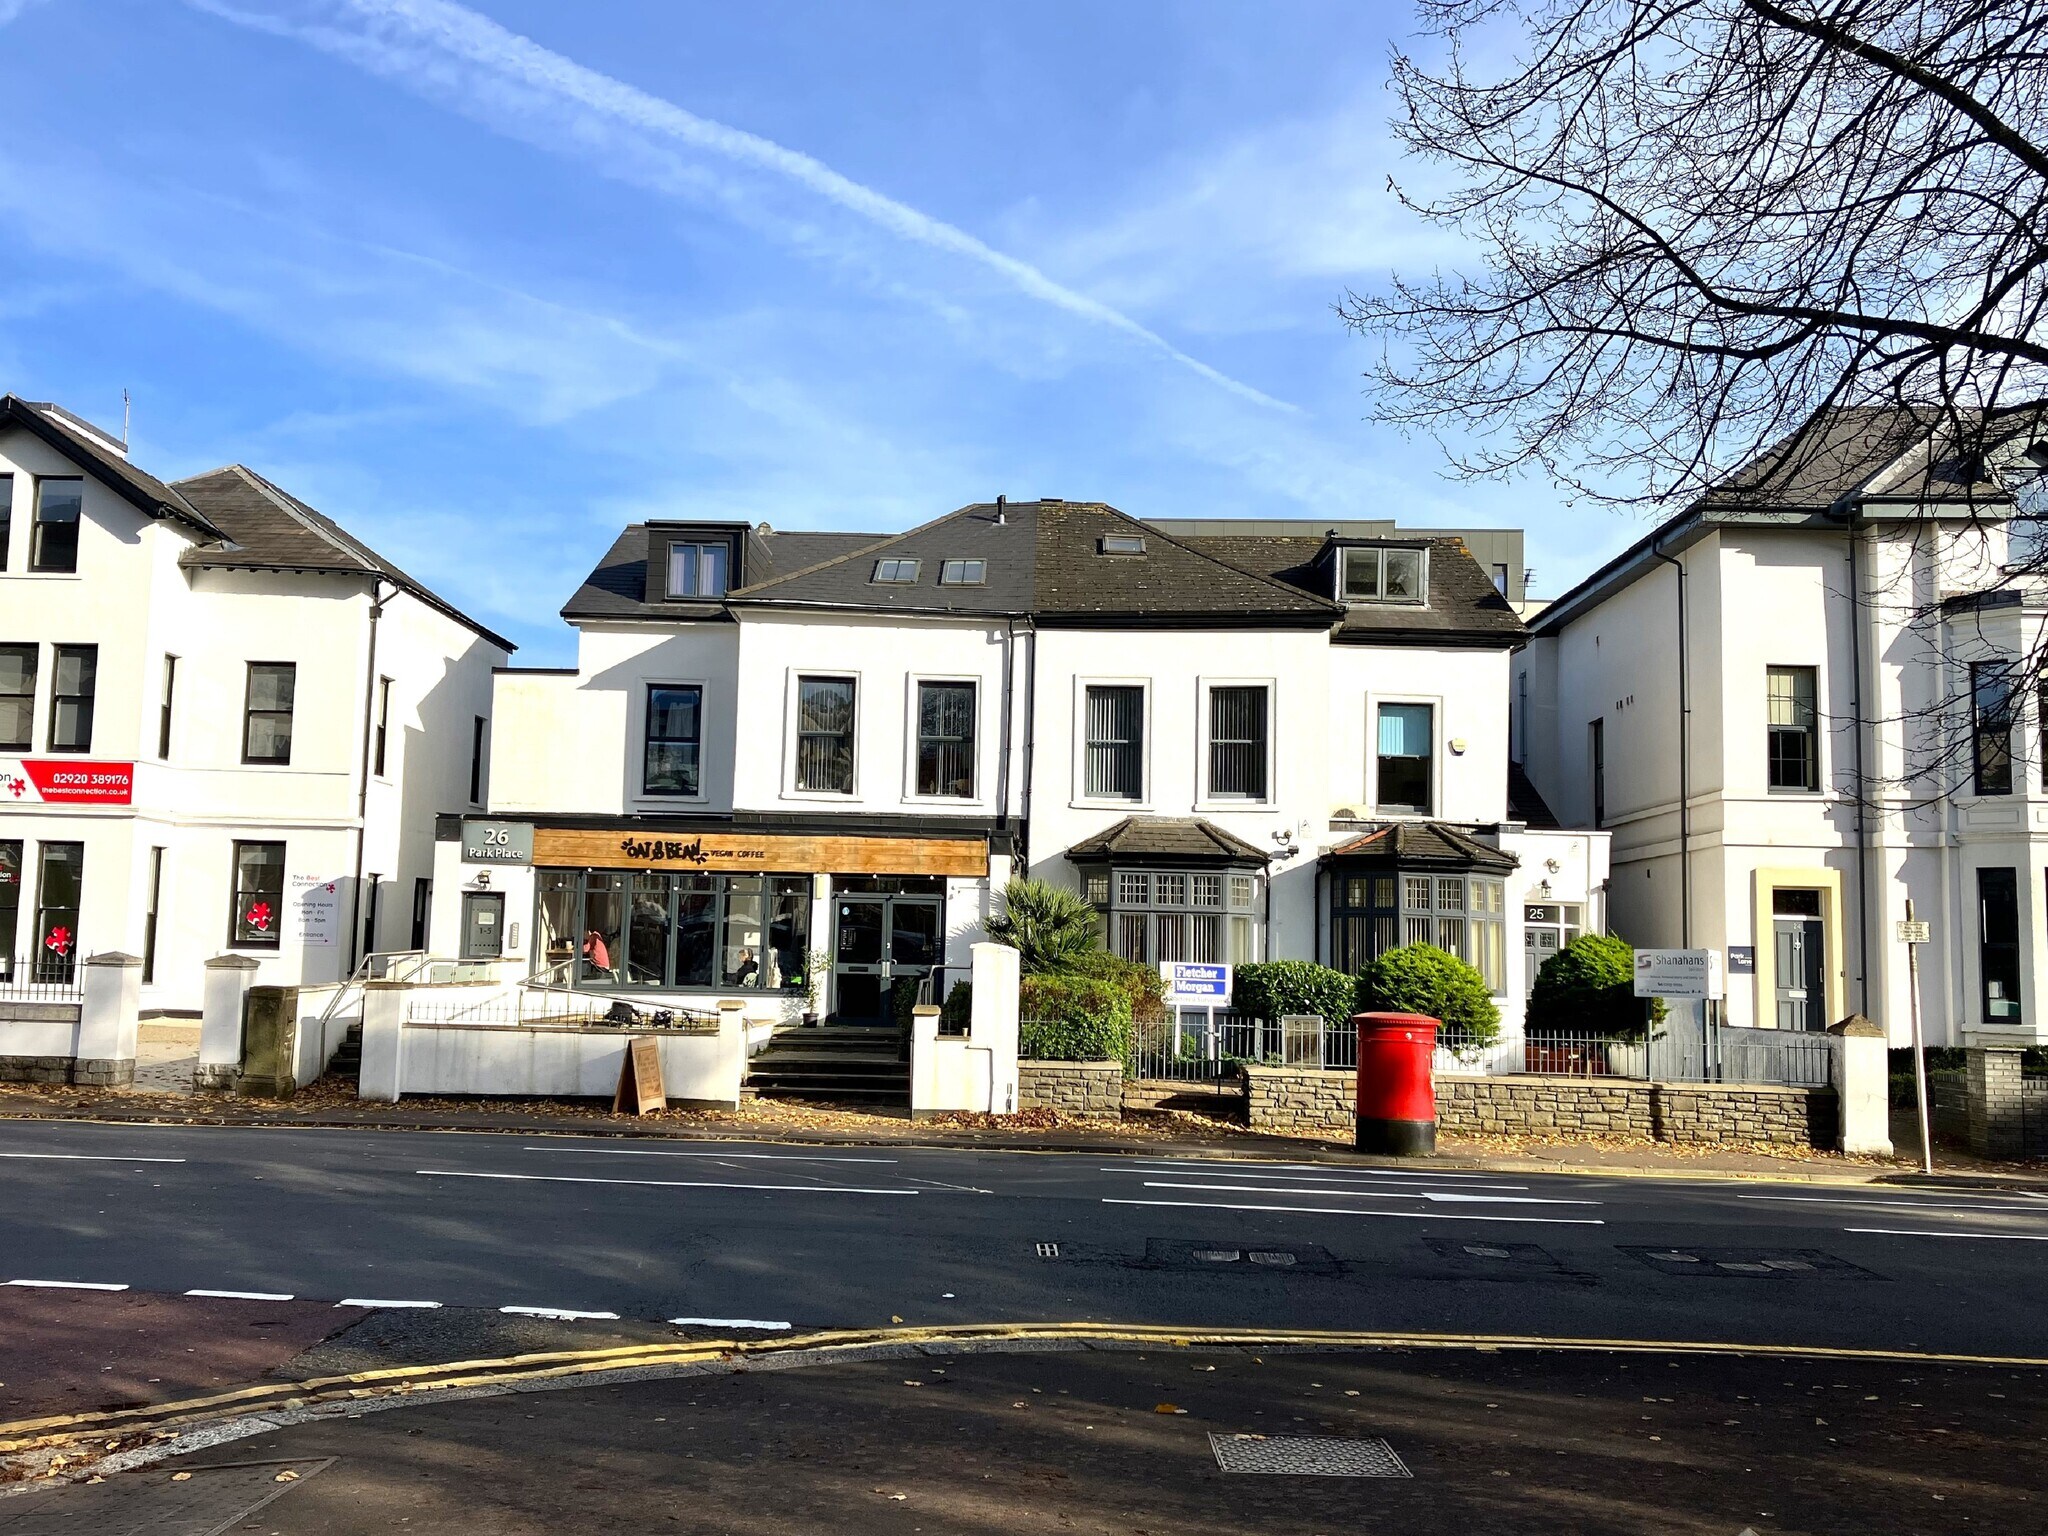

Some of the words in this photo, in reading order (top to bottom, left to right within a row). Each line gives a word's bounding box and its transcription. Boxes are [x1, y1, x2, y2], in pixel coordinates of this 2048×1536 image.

[53, 773, 88, 784] 02920
[90, 774, 129, 785] 389176
[42, 787, 128, 795] thebestconnection.co.uk
[483, 828, 509, 845] 26
[468, 847, 493, 858] Park
[495, 848, 524, 858] Place
[627, 842, 652, 859] OAT
[650, 841, 664, 861] &
[665, 838, 701, 862] BEAN
[737, 850, 765, 858] COFFEE
[1529, 908, 1544, 919] 25
[479, 927, 492, 935] 1-5
[1656, 954, 1704, 966] Shanahans
[1176, 966, 1217, 978] Fletcher
[1176, 981, 1214, 993] Morgan
